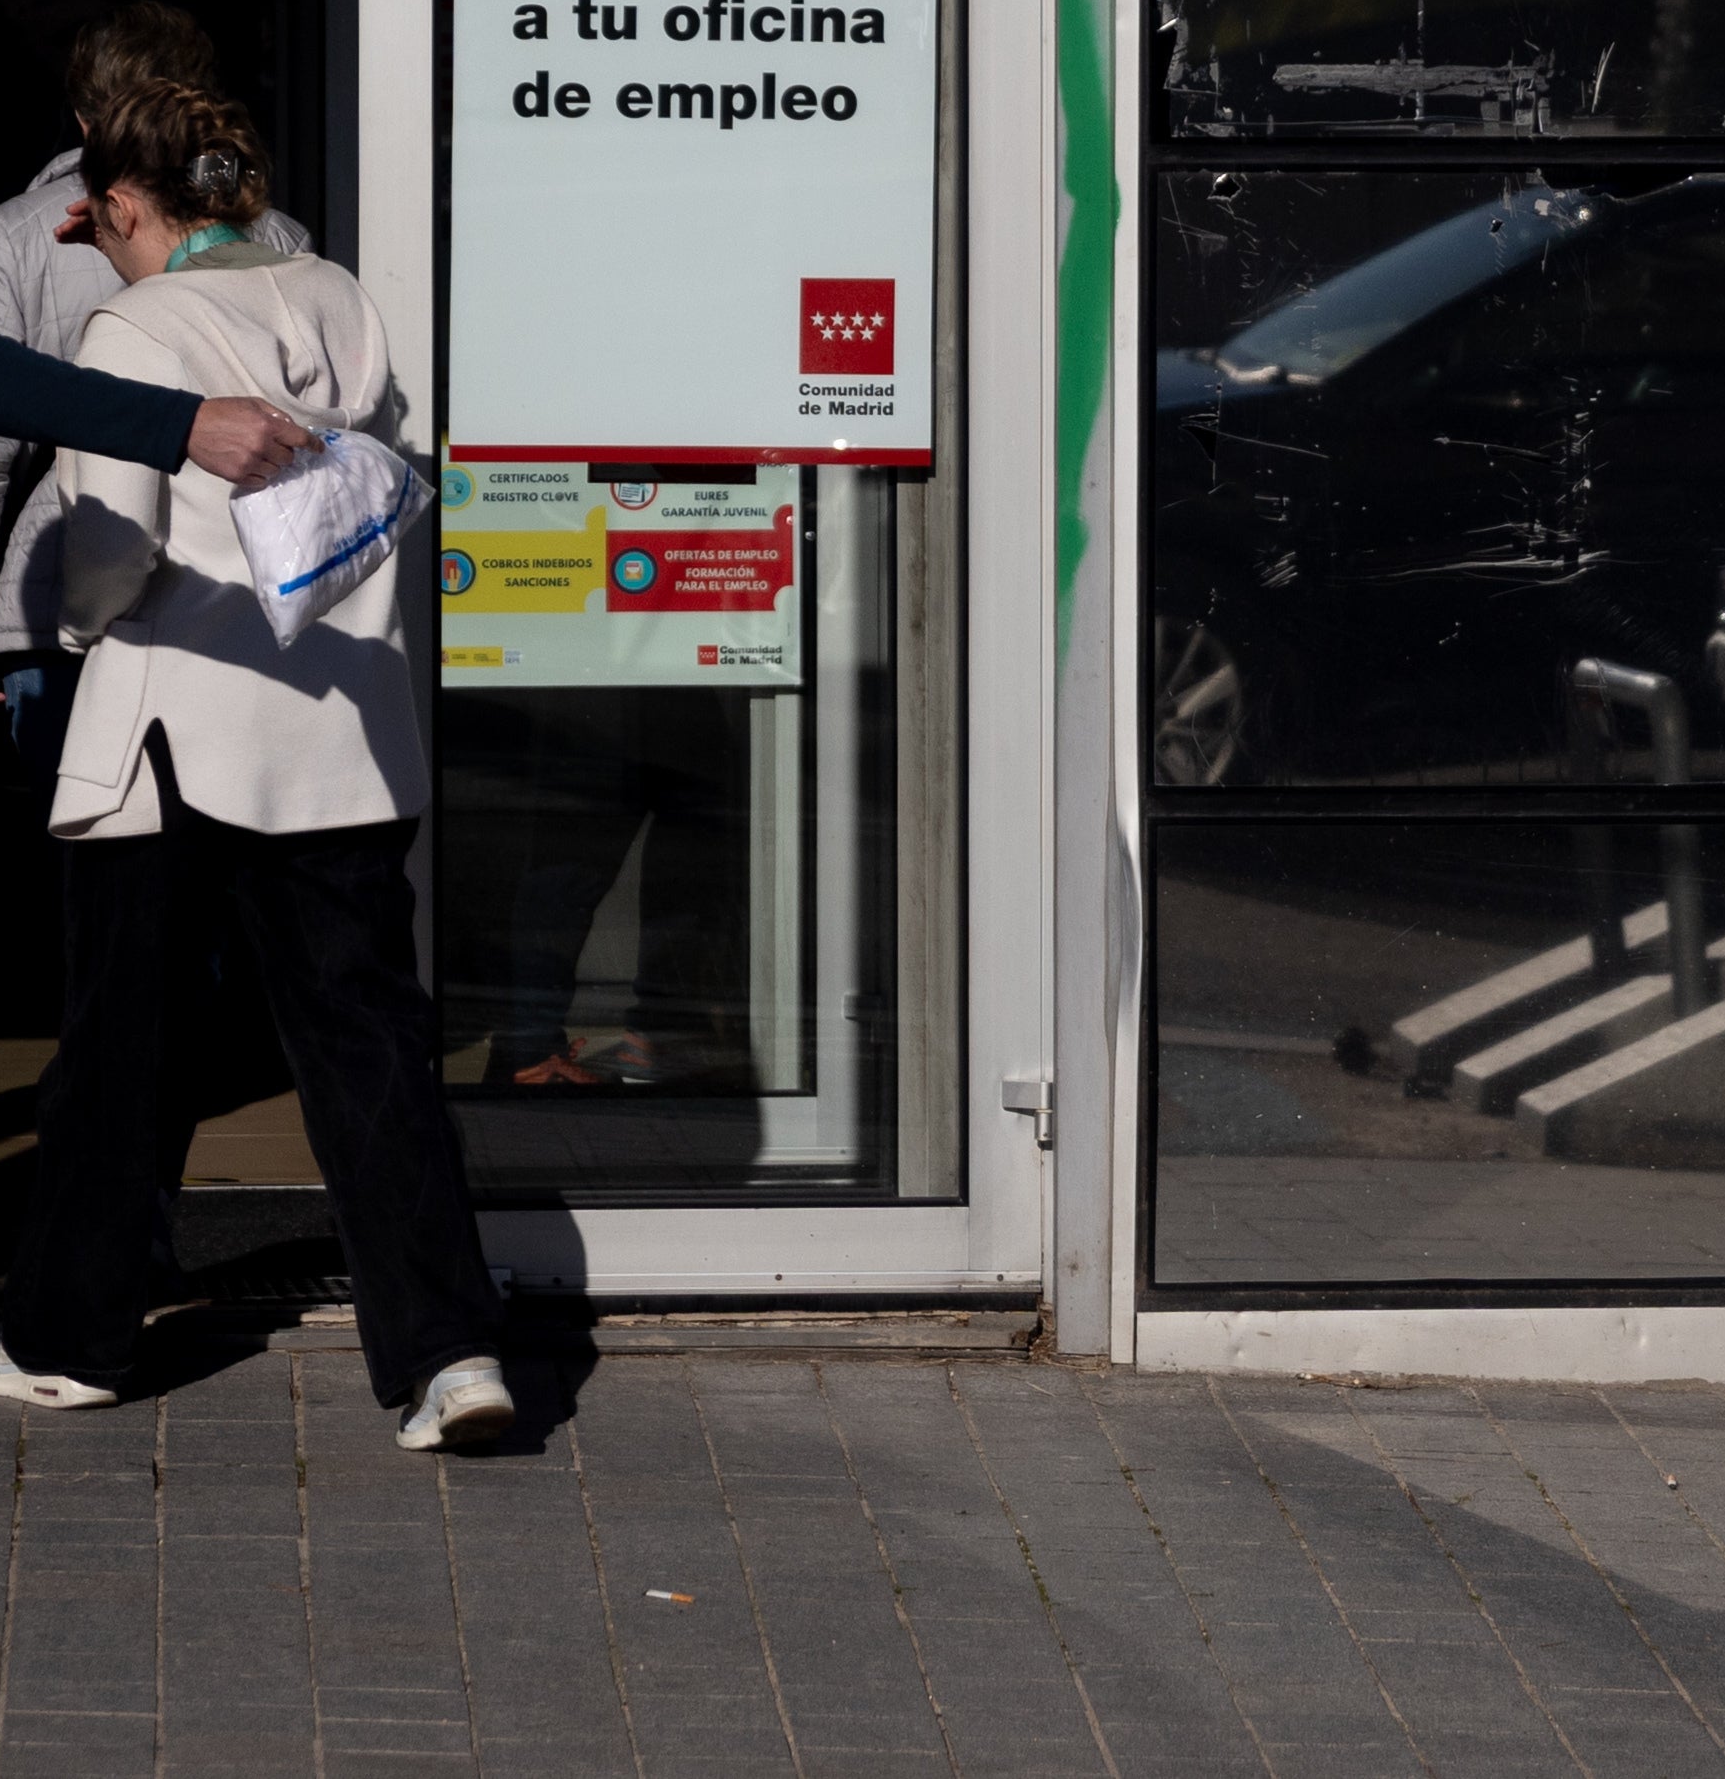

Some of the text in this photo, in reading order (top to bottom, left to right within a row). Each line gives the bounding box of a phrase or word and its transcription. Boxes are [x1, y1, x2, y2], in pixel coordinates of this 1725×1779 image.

[513, 5, 548, 40] a
[513, 71, 857, 129] de empleo
[799, 383, 894, 396] Comunidad
[799, 401, 893, 415] de Madrid
[489, 474, 569, 483] CERTIFICADOS
[483, 492, 578, 502] REGISTRO CL@VE
[695, 491, 728, 501] EURES
[662, 505, 767, 517] GARANTÍA JUVENIL
[665, 550, 778, 560] OFERTAS DE EMPLEO
[482, 558, 592, 568] COBROS INDEBIDOS
[686, 565, 755, 578] FORMACIÓN
[505, 578, 569, 587] SANCIONES
[676, 581, 768, 590] PARA EL EMPLEO
[720, 655, 735, 664] de
